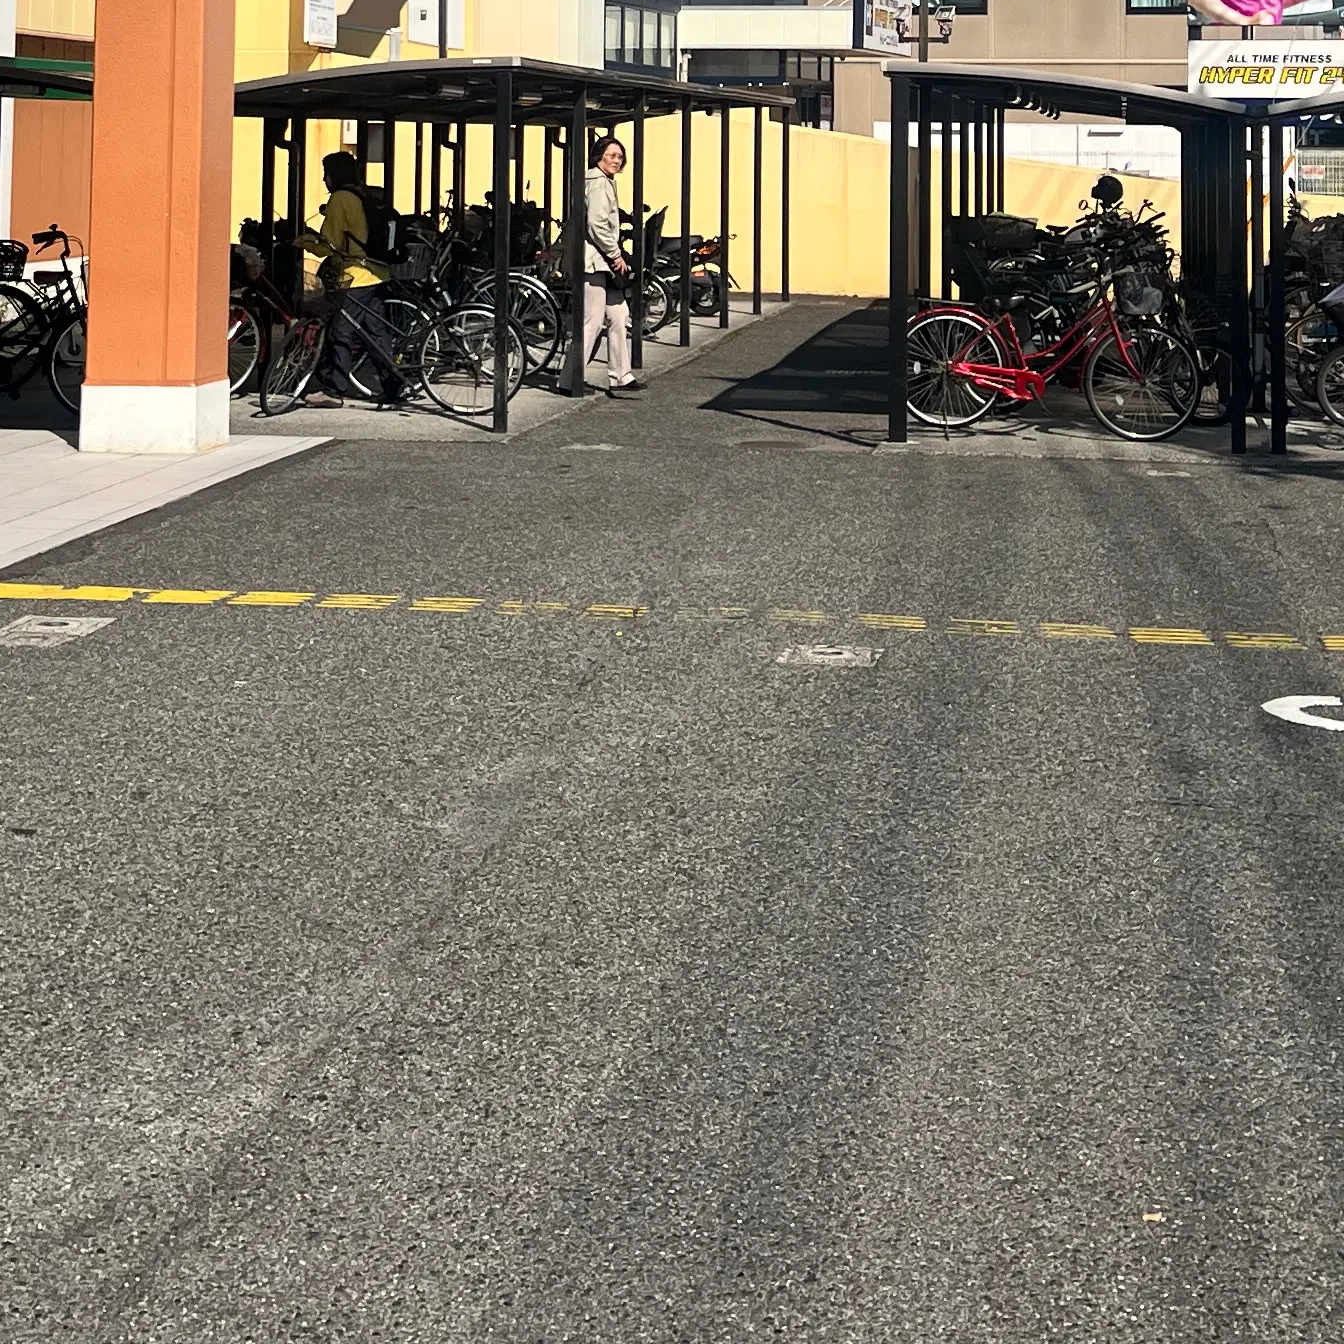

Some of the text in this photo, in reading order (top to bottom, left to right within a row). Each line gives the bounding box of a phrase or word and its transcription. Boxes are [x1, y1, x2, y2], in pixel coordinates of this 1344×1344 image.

[1227, 54, 1332, 63] ALL TIME FITNESS
[1199, 66, 1276, 84] HYPER
[1279, 66, 1318, 84] FIT
